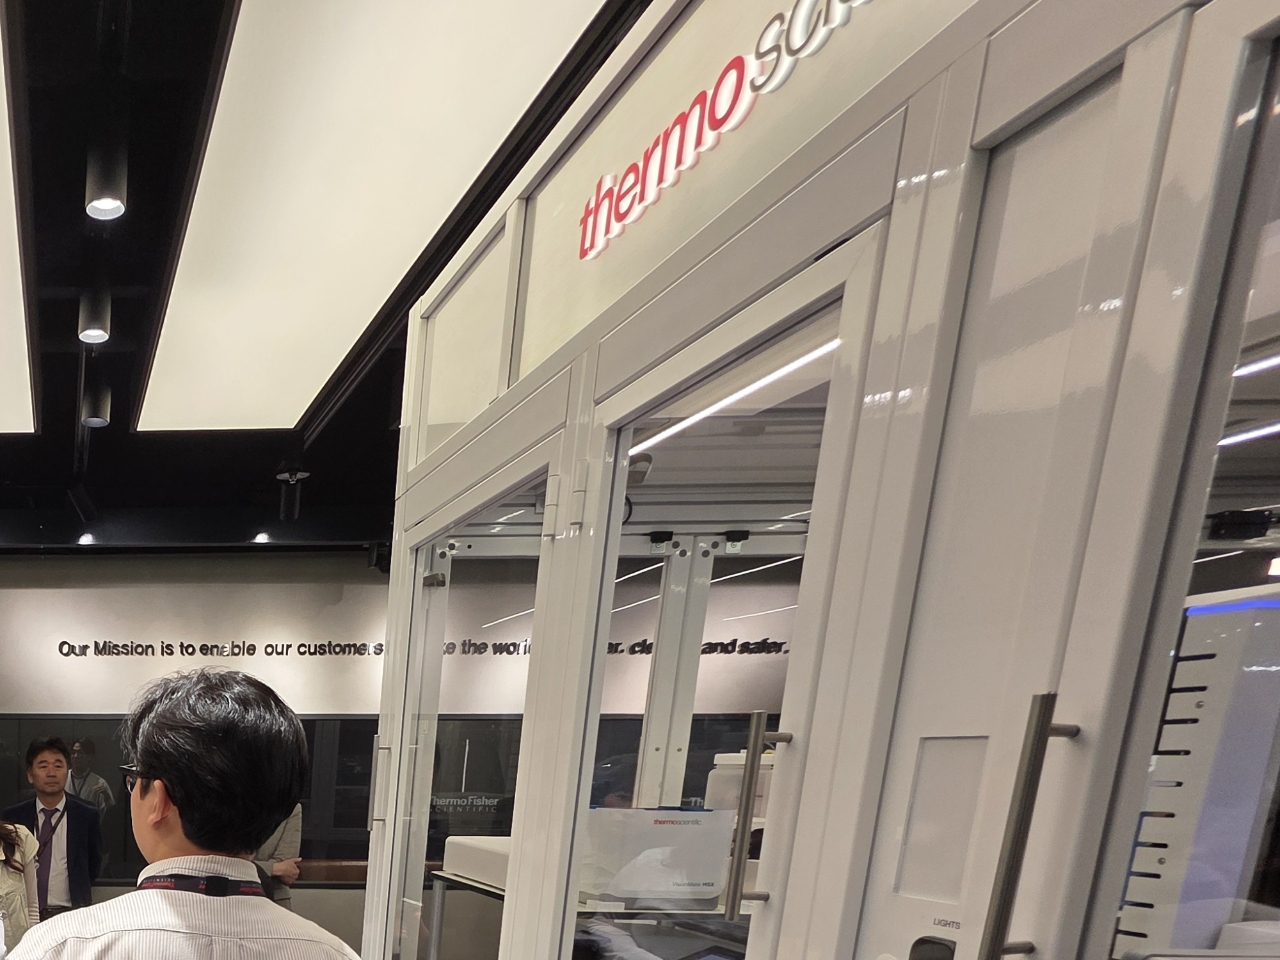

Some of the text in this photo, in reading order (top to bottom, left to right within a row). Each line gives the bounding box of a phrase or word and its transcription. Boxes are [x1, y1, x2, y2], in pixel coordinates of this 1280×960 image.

[578, 0, 871, 261] thermosc
[58, 640, 90, 657] Our
[94, 640, 155, 657] Mission
[160, 641, 175, 656] is
[179, 641, 197, 656] to
[199, 640, 257, 657] enable
[264, 643, 292, 656] our
[297, 640, 384, 656] customers
[461, 639, 489, 655] the
[701, 638, 738, 655] and
[737, 637, 790, 655] safer.
[933, 918, 961, 929] LIGHTS
